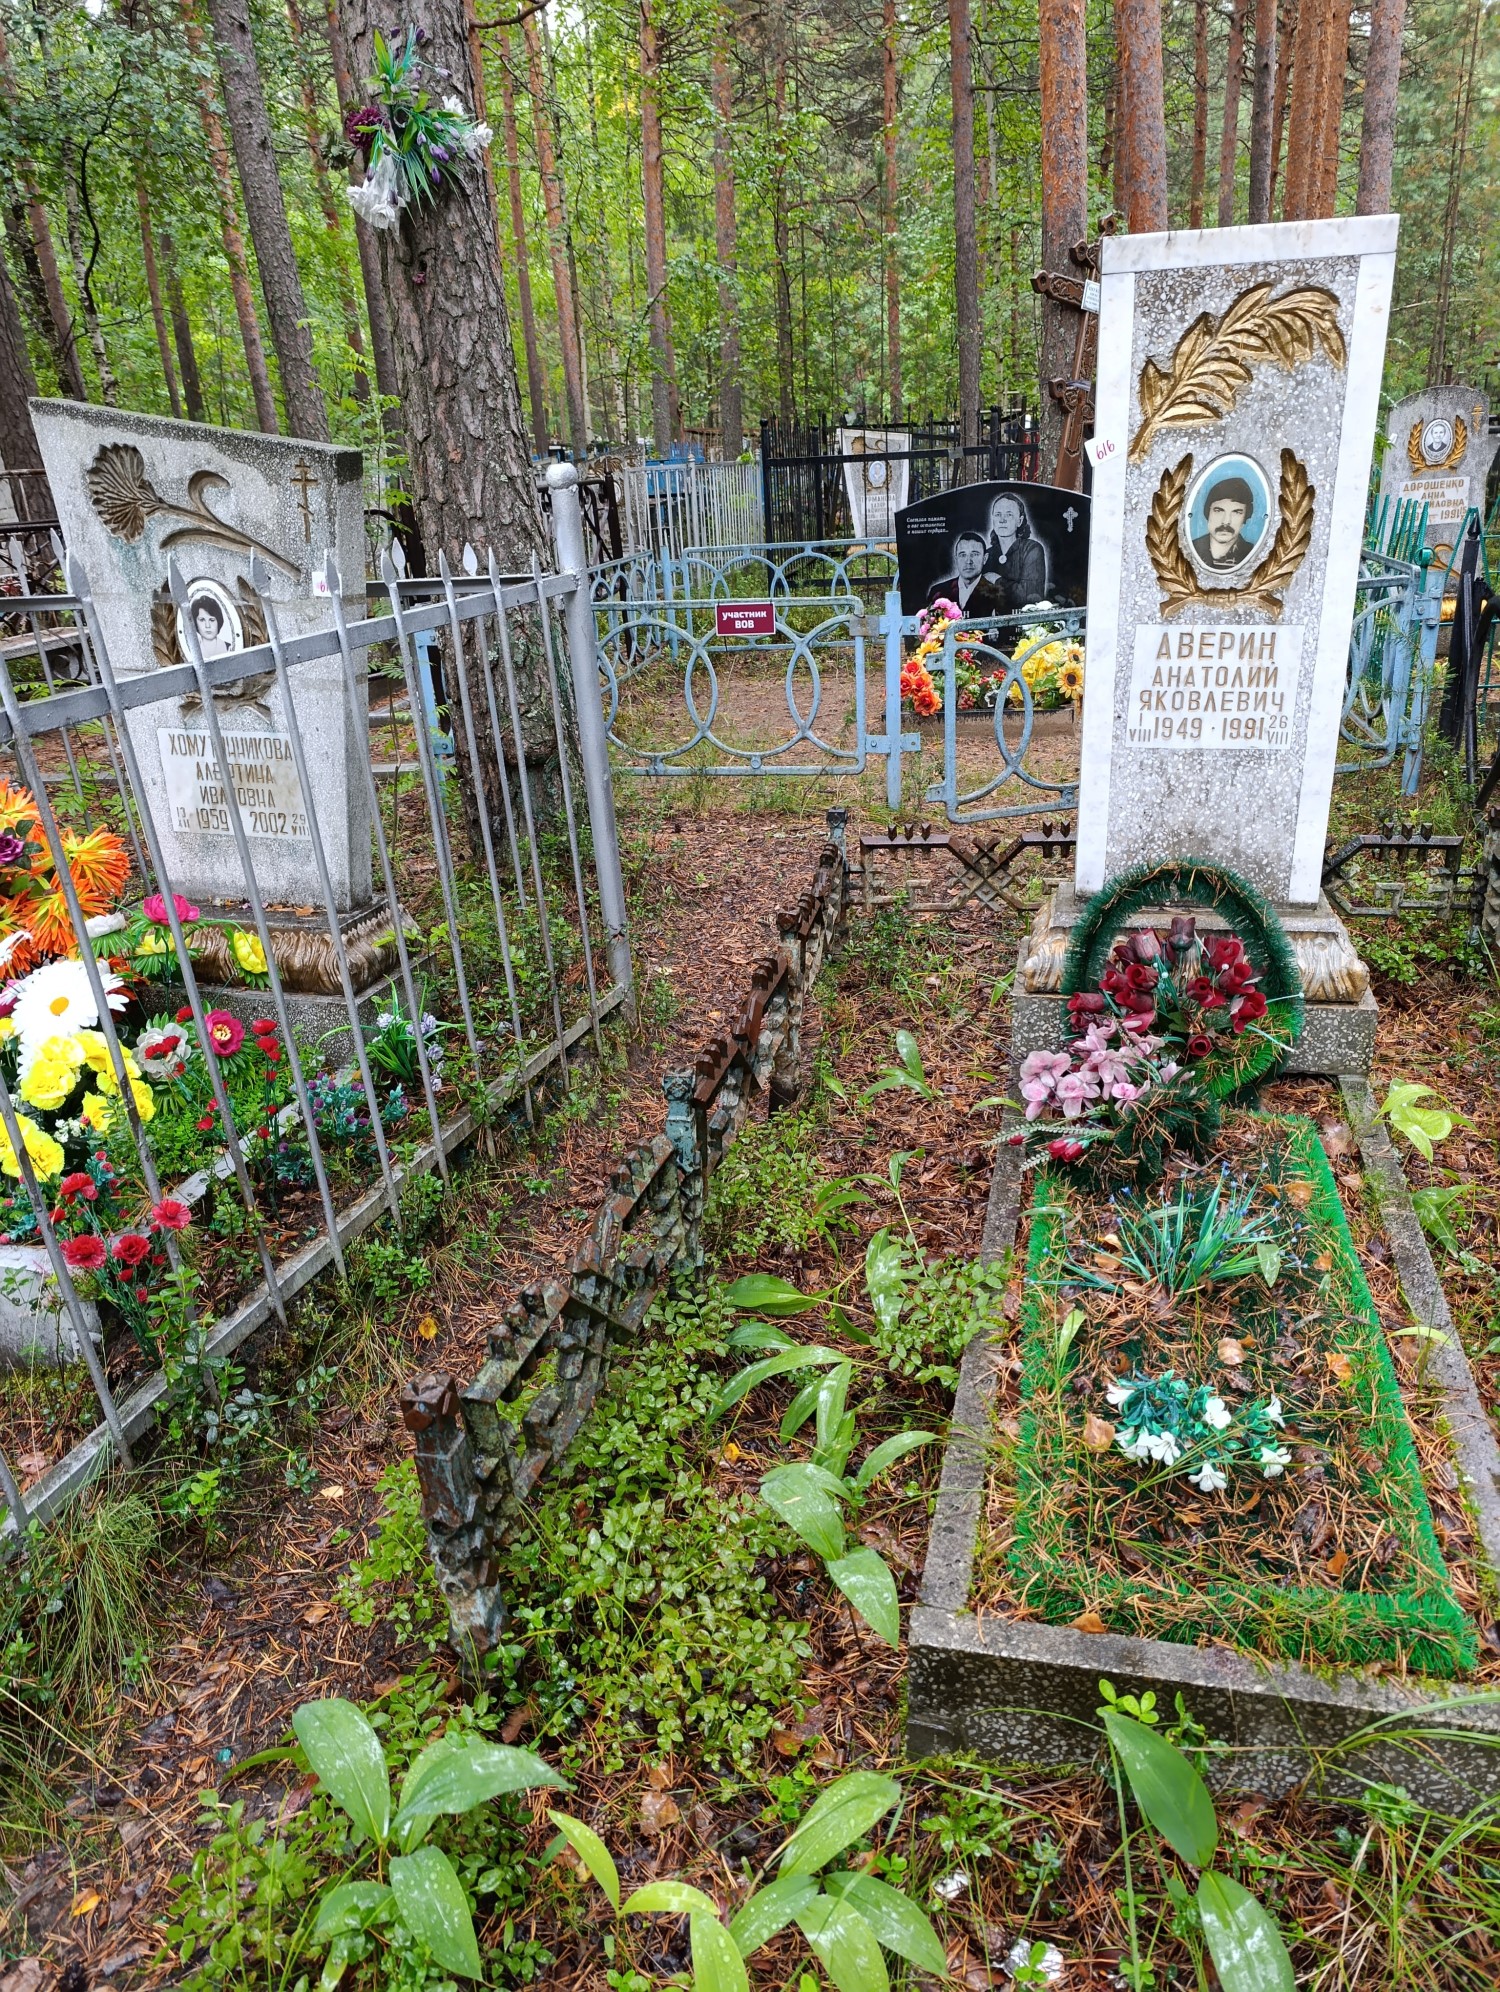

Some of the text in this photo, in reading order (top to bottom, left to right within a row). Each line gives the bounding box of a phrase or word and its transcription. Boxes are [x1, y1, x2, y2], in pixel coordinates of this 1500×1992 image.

[1096, 440, 1115, 460] 616
[1403, 479, 1464, 491] ДОРОШЕНКО
[1421, 491, 1445, 500] АННА
[1440, 508, 1460, 520] 1991
[722, 611, 767, 620] участник
[735, 620, 754, 628] ВОВ
[1156, 631, 1277, 660] АВЕРИН
[1139, 689, 1285, 713] ЯКОВЛЕВИЧ
[1153, 717, 1265, 741] 1949 1991
[1268, 714, 1289, 729] 26
[1128, 728, 1151, 742] VIII
[1266, 730, 1289, 745] VIII
[168, 733, 293, 761] ХОМУТННИКОВА
[200, 785, 276, 808] ИВАОВНА
[195, 807, 288, 836] 1959 2002
[291, 813, 306, 825] 29
